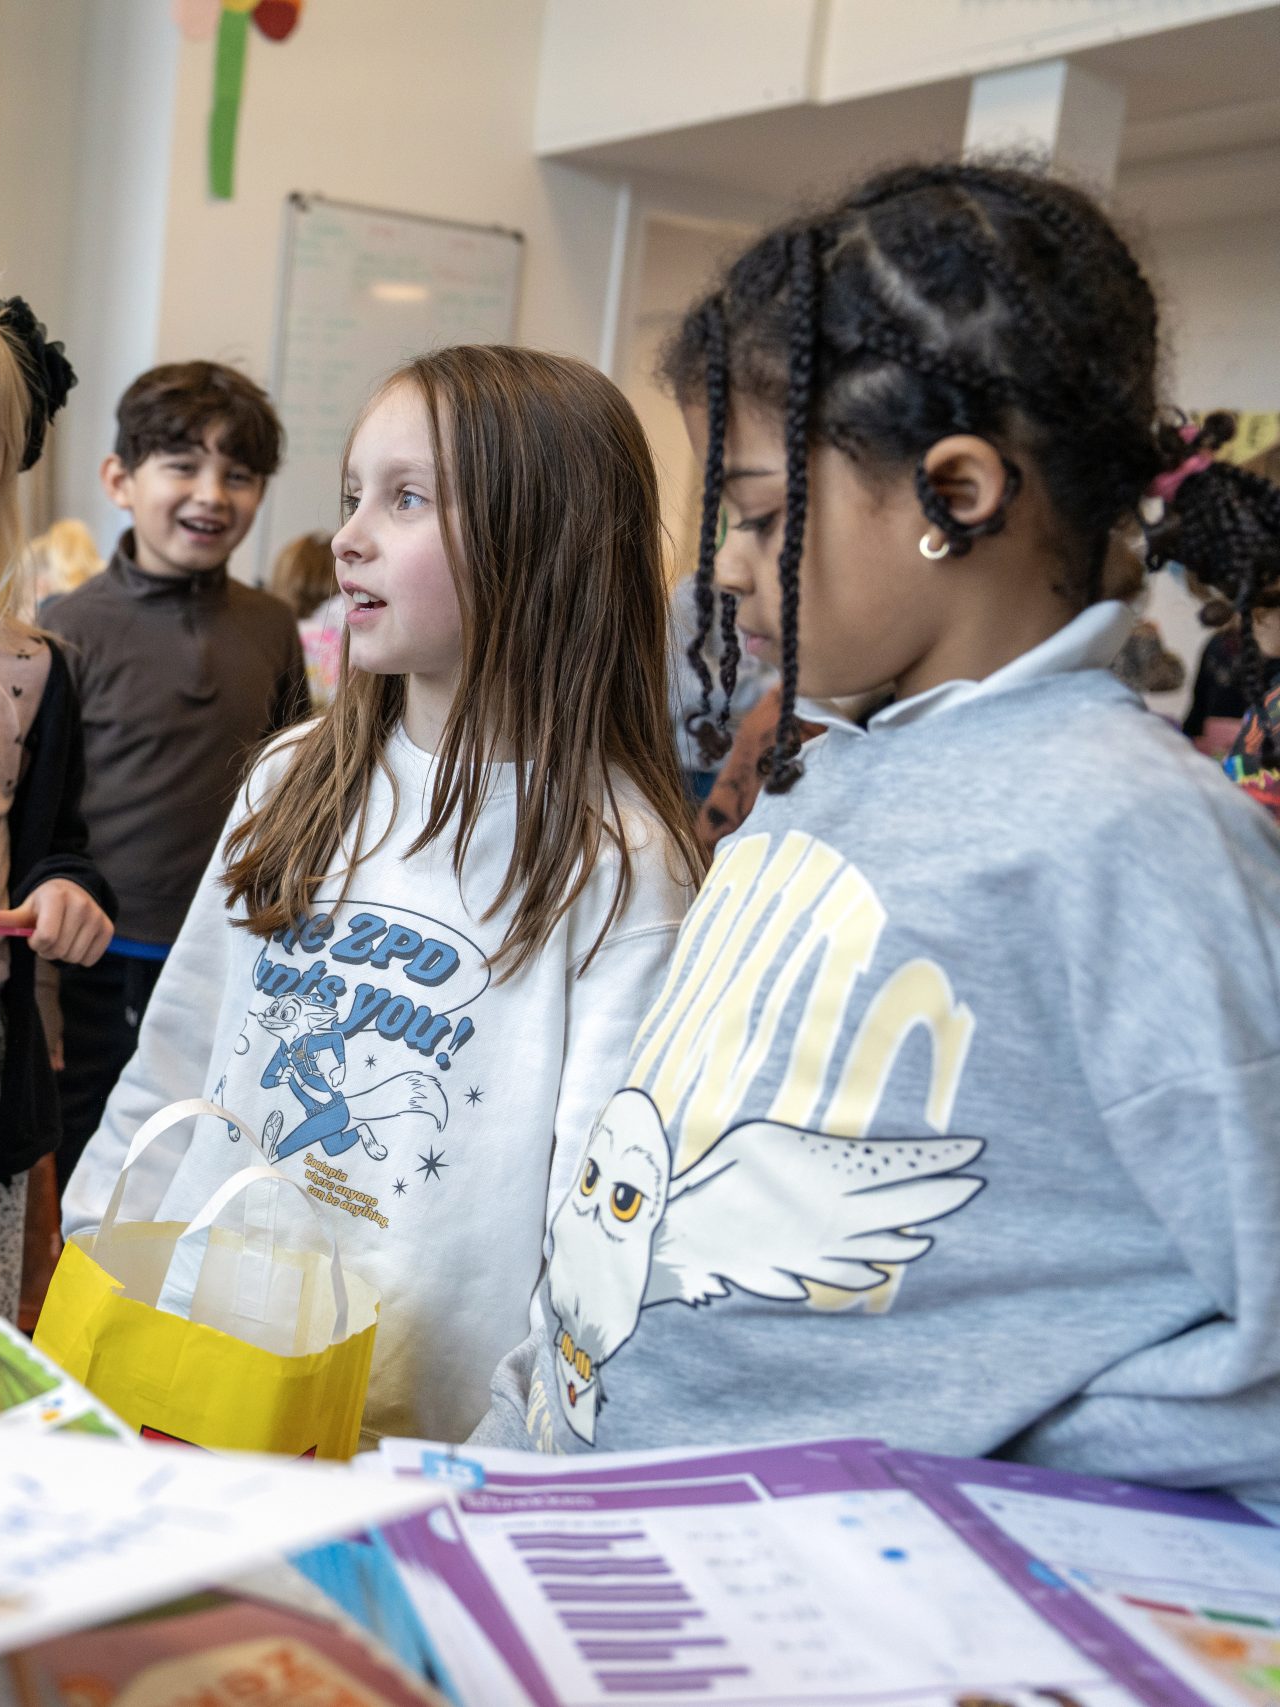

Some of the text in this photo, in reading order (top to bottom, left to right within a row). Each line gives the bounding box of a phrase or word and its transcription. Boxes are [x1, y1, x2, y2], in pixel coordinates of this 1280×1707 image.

[331, 983, 476, 1072] you!
[305, 1169, 379, 1208] where anyone
[307, 1184, 389, 1229] can be anything.
